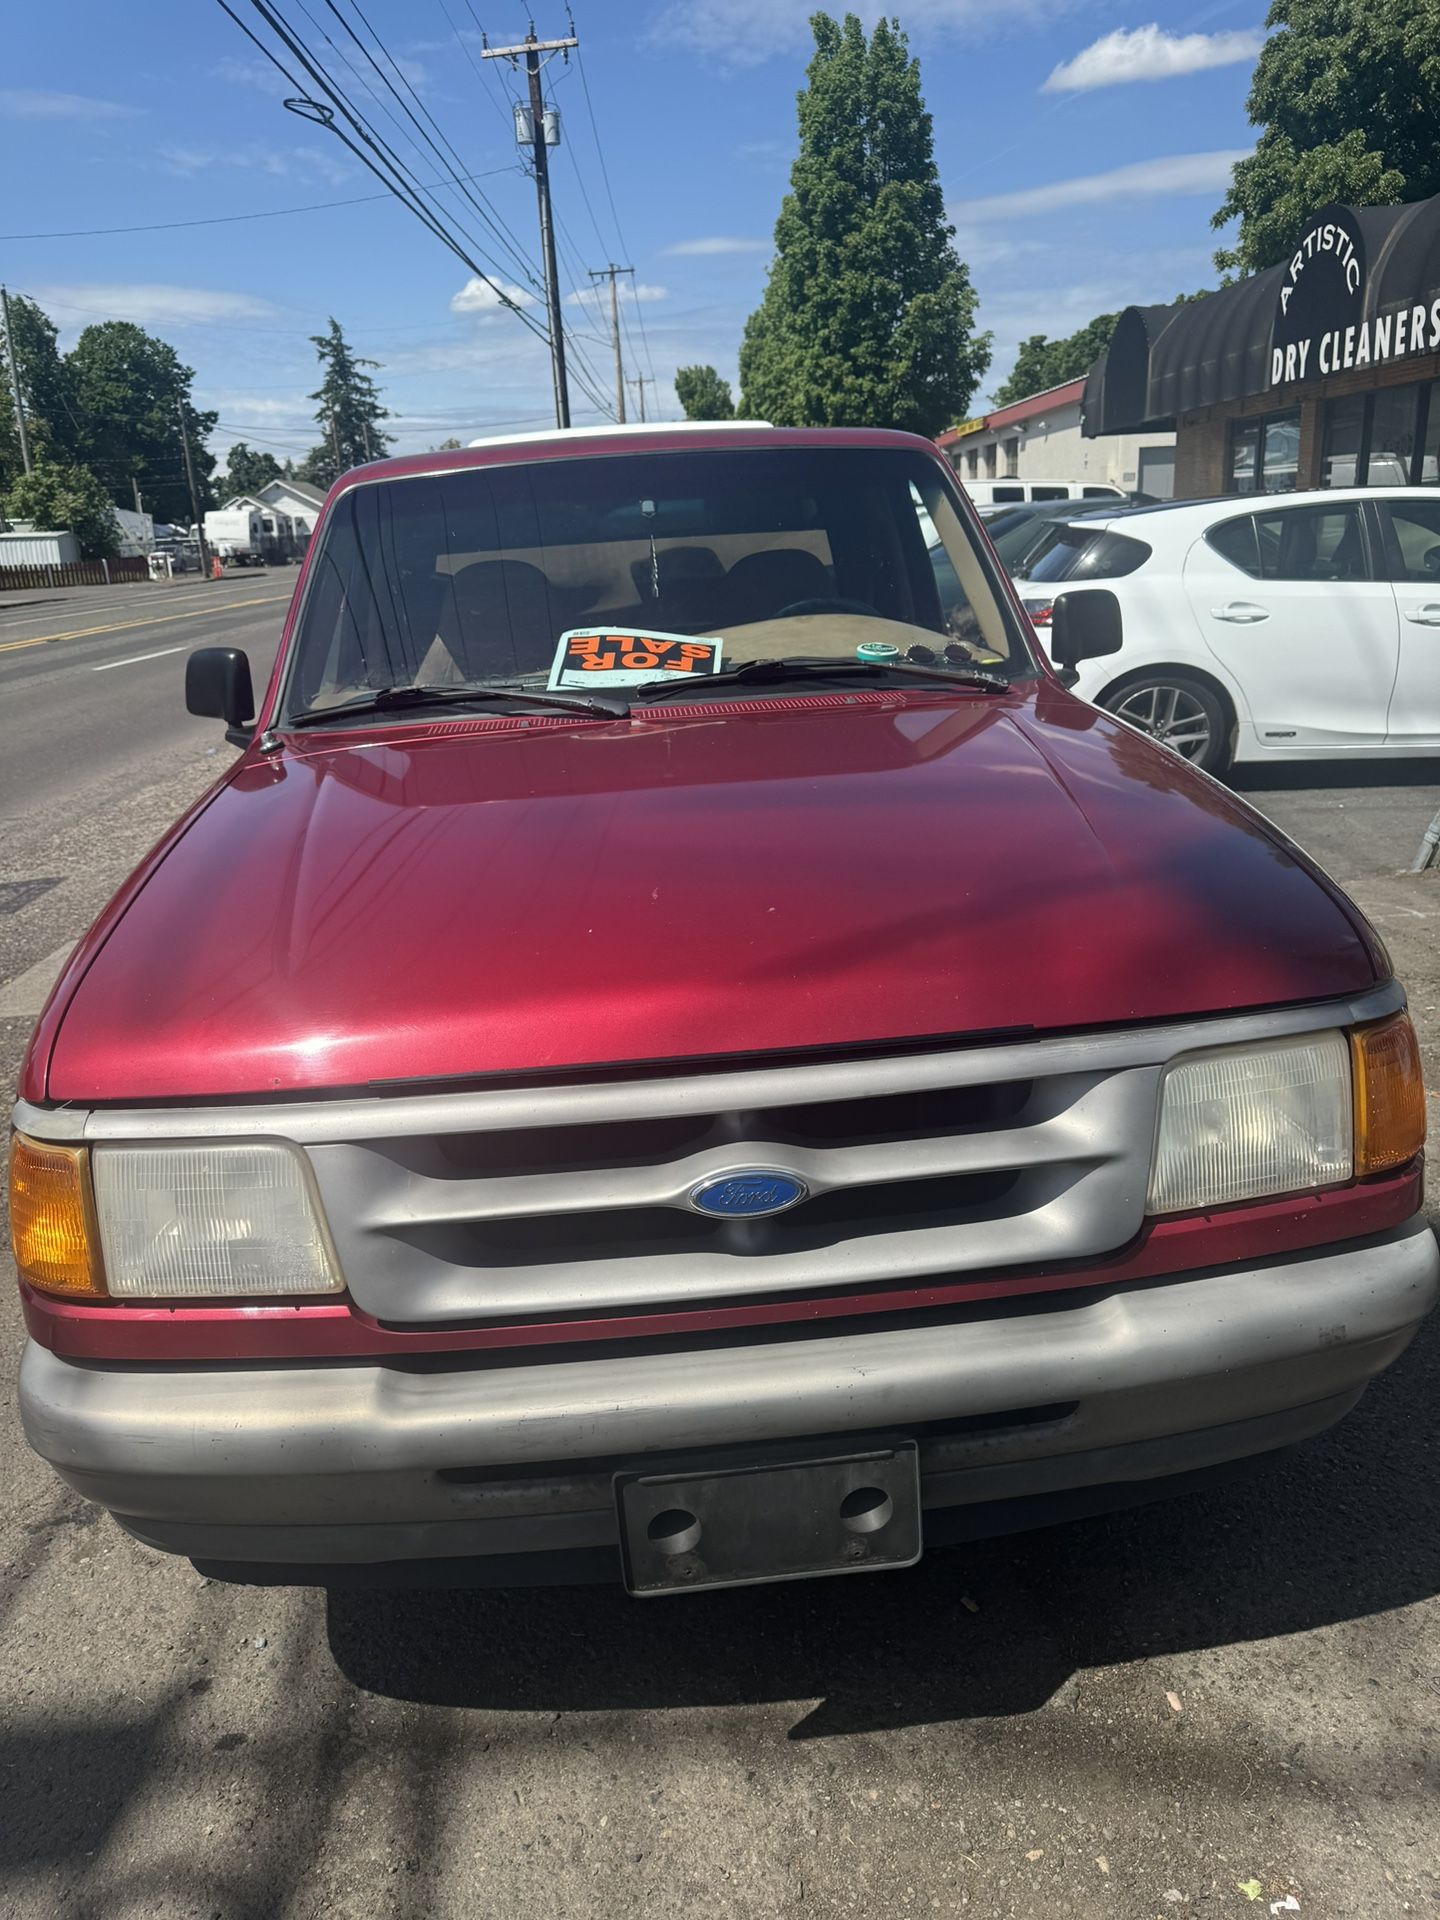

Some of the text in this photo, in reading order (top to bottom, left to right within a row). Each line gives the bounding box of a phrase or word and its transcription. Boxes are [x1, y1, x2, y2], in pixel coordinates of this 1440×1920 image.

[1280, 224, 1360, 316] ARTISTIC
[1271, 298, 1440, 386] DRY CLEANERS
[569, 635, 713, 659] SALE
[581, 652, 694, 672] FOR
[719, 1180, 778, 1207] Ford
